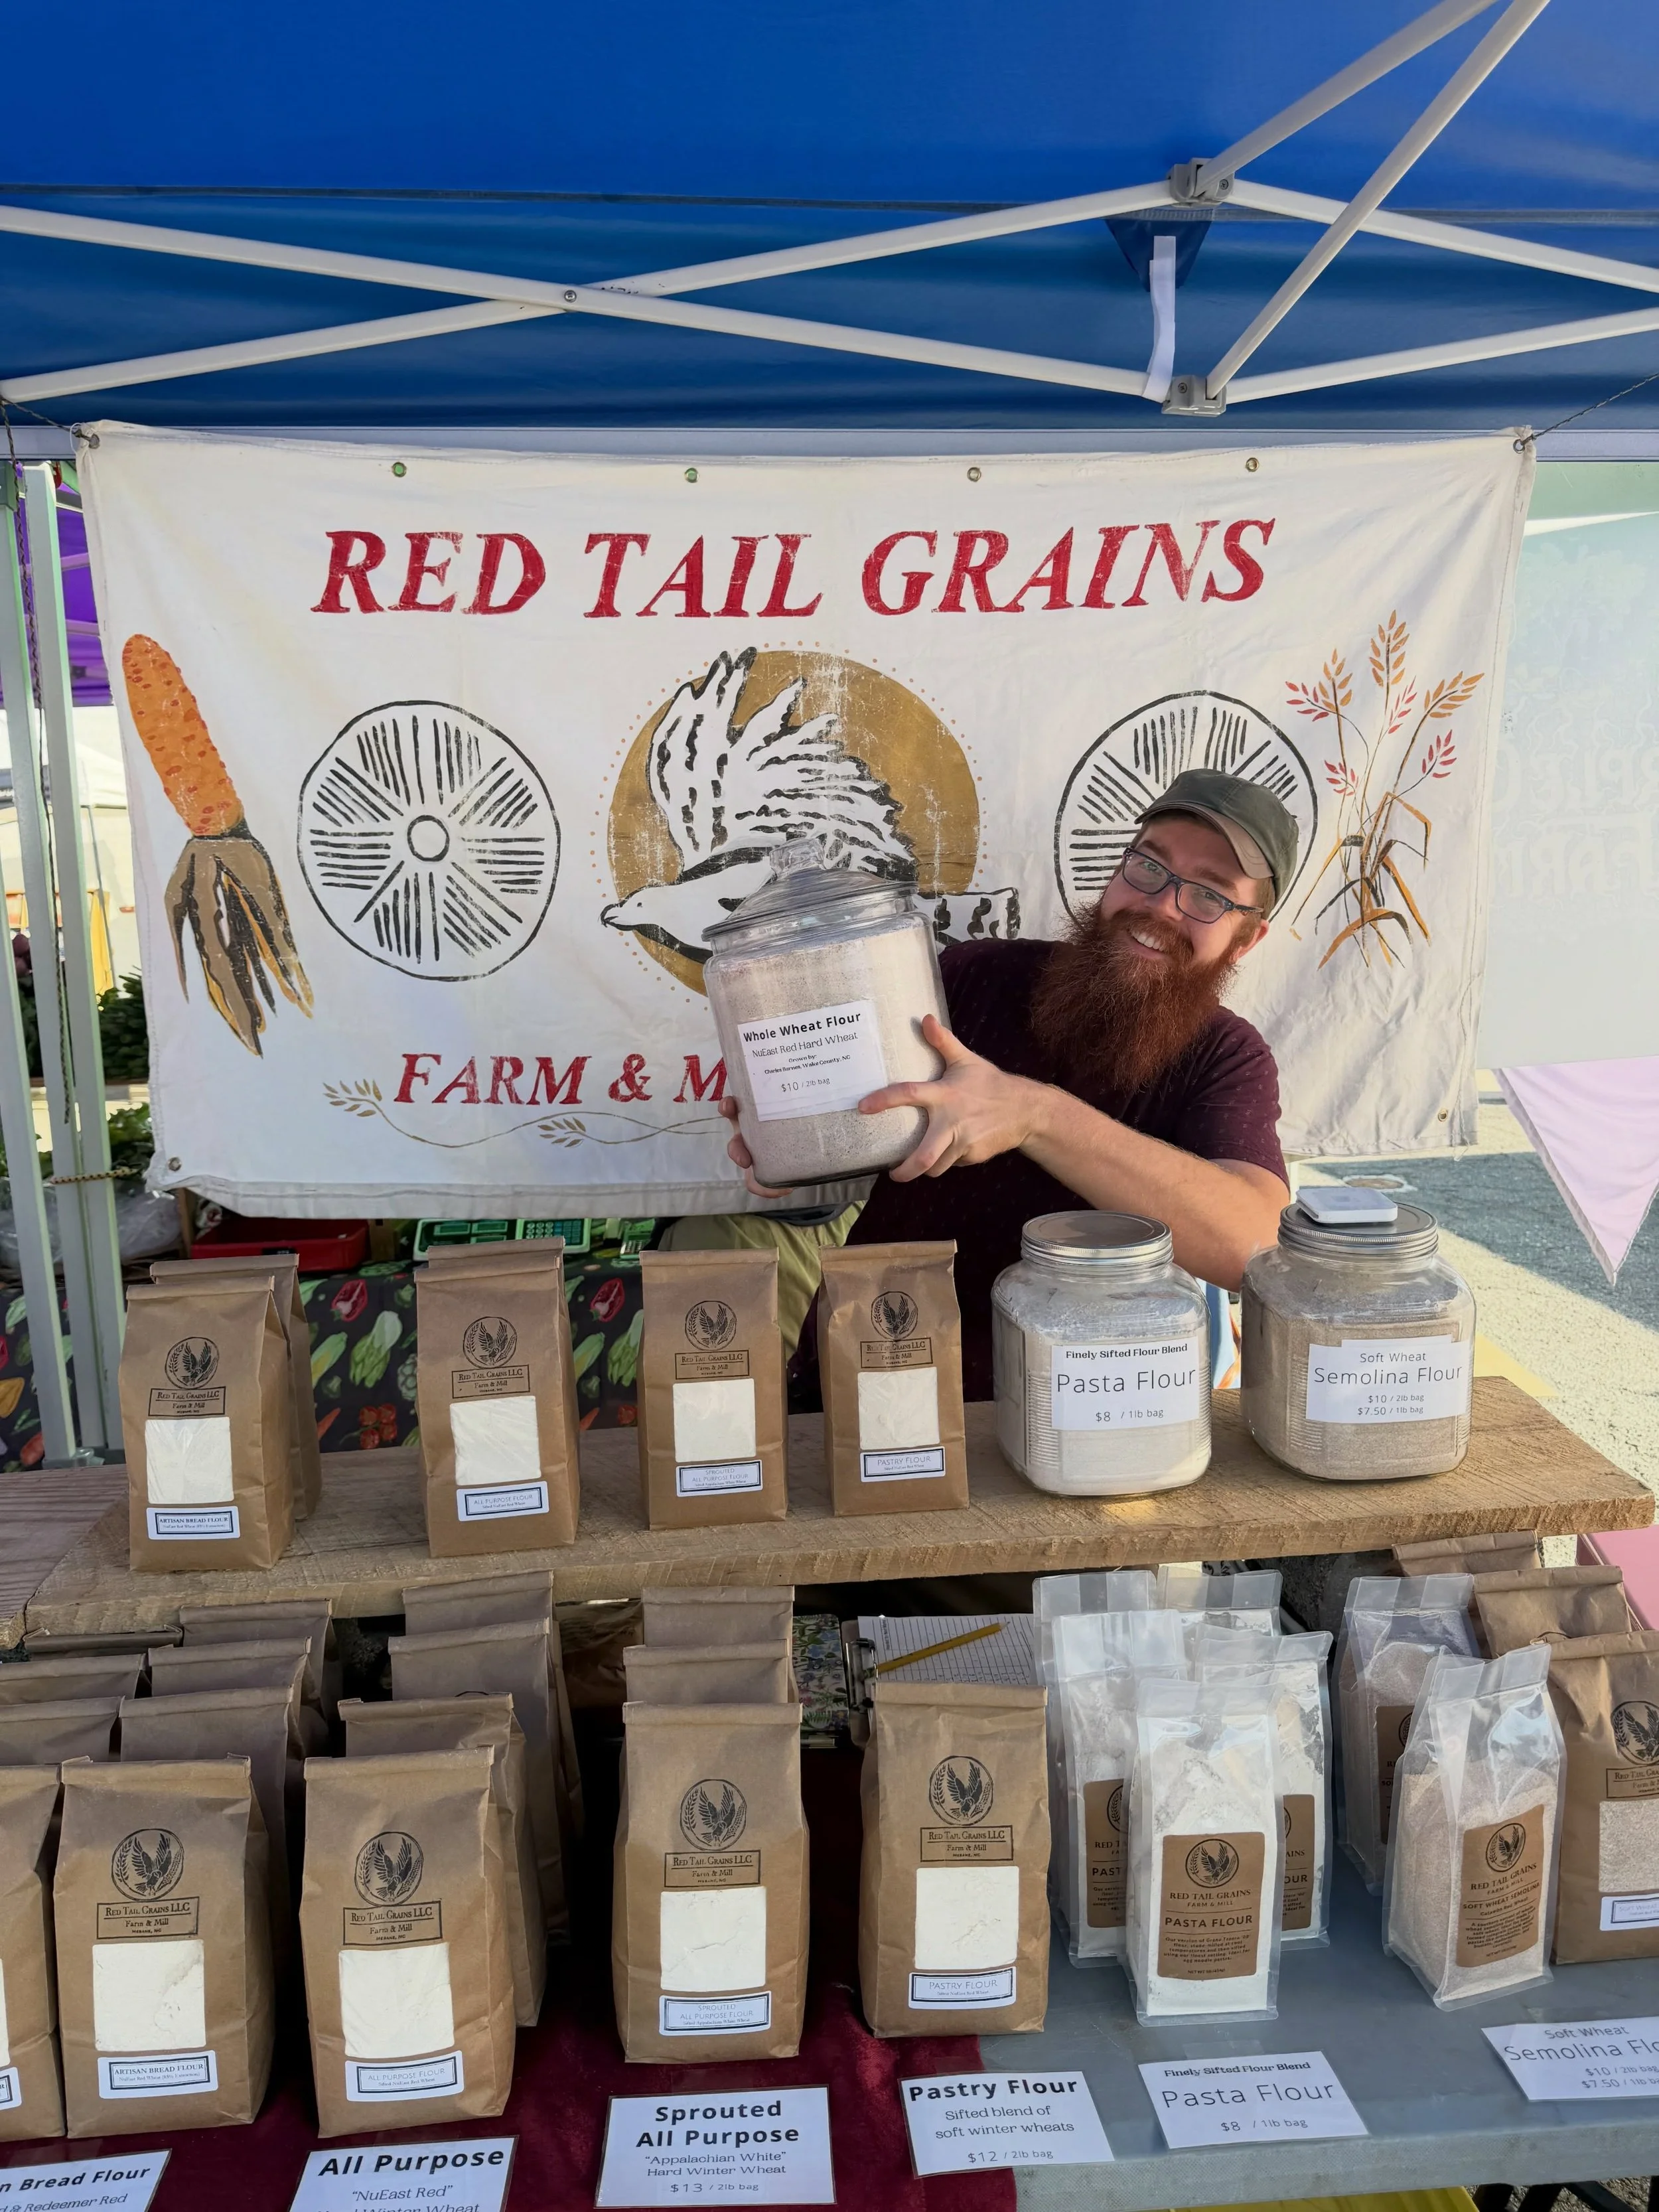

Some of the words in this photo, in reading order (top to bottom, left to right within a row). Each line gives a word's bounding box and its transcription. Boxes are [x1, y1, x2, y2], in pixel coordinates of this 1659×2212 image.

[311, 530, 546, 615] RED
[583, 532, 823, 618] TAIL
[862, 517, 1277, 615] GRAINS
[743, 1027, 776, 1042] Whole
[779, 1021, 822, 1037] Wheat
[826, 1013, 861, 1027] Flour
[753, 1047, 778, 1057] NuEast
[780, 1043, 797, 1053] Red
[799, 1038, 822, 1050] Hard
[825, 1031, 858, 1045] Wheat
[394, 1053, 592, 1105] FARM
[609, 1053, 652, 1102] &
[673, 1054, 727, 1104] M
[781, 1082, 799, 1092] $10
[1066, 1351, 1097, 1360] Finely
[1133, 1348, 1159, 1357] Flour
[1161, 1343, 1188, 1354] Blend
[1360, 1353, 1384, 1363] Soft
[1389, 1352, 1426, 1362] Wheat
[1057, 1374, 1125, 1393] Pasta
[1137, 1369, 1196, 1390] Flour
[1314, 1367, 1408, 1384] Semolina
[1417, 1366, 1462, 1382] Flour
[1096, 1411, 1111, 1422] $8
[1147, 1409, 1163, 1418] bag
[1358, 1407, 1386, 1416] $7.50
[929, 1831, 943, 1840] RED
[987, 1830, 1005, 1839] LLC
[673, 1858, 688, 1866] RED
[734, 1855, 753, 1864] LLC
[1092, 1867, 1120, 1876] PAST
[1492, 1876, 1509, 1887] TAIL
[1510, 1863, 1537, 1879] GRAINS
[1284, 1874, 1307, 1884] OUR
[1216, 1889, 1251, 1899] GRAINS
[1485, 1897, 1508, 1907] WHEAT
[1510, 1883, 1540, 1899] SEMOLINA
[106, 1907, 121, 1917] RED
[123, 1906, 139, 1915] TAIL
[141, 1905, 169, 1914] GRAINS
[171, 1902, 190, 1913] LLC
[351, 1912, 365, 1922] RED
[367, 1911, 385, 1921] TAIL
[386, 1909, 412, 1919] GRAINS
[413, 1907, 432, 1917] LLC
[1165, 1917, 1207, 1927] PASTA
[1212, 1915, 1252, 1927] FLOUR
[370, 1926, 389, 1935] Farm
[398, 1923, 412, 1932] Mill
[929, 1982, 962, 1990] PASTRY
[966, 1980, 997, 1990] FLOUR
[729, 2010, 753, 2018] FLOUR
[1544, 2028, 1577, 2039] Soft
[1578, 2026, 1629, 2037] Wheat
[1504, 2043, 1623, 2061] Semolina
[1627, 2039, 1659, 2055] Flo
[383, 2072, 416, 2081] PURPOSE
[419, 2068, 445, 2078] FLOUR
[1164, 2069, 1200, 2077] Finely
[1203, 2066, 1240, 2075] Sifted
[1242, 2065, 1275, 2073] Flour
[1276, 2062, 1311, 2071] Blend
[1585, 2067, 1611, 2076] $10
[909, 2083, 997, 2101] Pastry
[1007, 2079, 1076, 2095] Flour
[1581, 2079, 1620, 2088] $7.50
[1162, 2088, 1246, 2108] Pasta
[1257, 2083, 1333, 2102] Flour
[655, 2101, 781, 2125] Sprouted
[946, 2108, 988, 2120] Sifted
[991, 2106, 1033, 2117] blend
[1037, 2106, 1050, 2115] of
[935, 2127, 964, 2139] soft
[968, 2124, 1017, 2136] winter
[1021, 2122, 1074, 2132] wheats
[1220, 2121, 1241, 2132] $8
[1262, 2119, 1280, 2128] 1lb
[1285, 2118, 1308, 2128] bag
[636, 2130, 672, 2148] All
[685, 2128, 799, 2148] Purpose
[318, 2156, 364, 2176] All
[374, 2150, 504, 2175] Purpose
[968, 2151, 998, 2164] $12
[1012, 2150, 1029, 2159] 2lb
[1033, 2150, 1054, 2160] bag
[648, 2168, 682, 2176] Hard
[687, 2167, 736, 2175] Winter
[740, 2166, 786, 2174] Wheat
[19, 2172, 86, 2191] Bread
[92, 2166, 151, 2184] Flour
[670, 2183, 703, 2193] $13
[25, 2197, 97, 2212] Redeemer
[100, 2193, 127, 2205] Red
